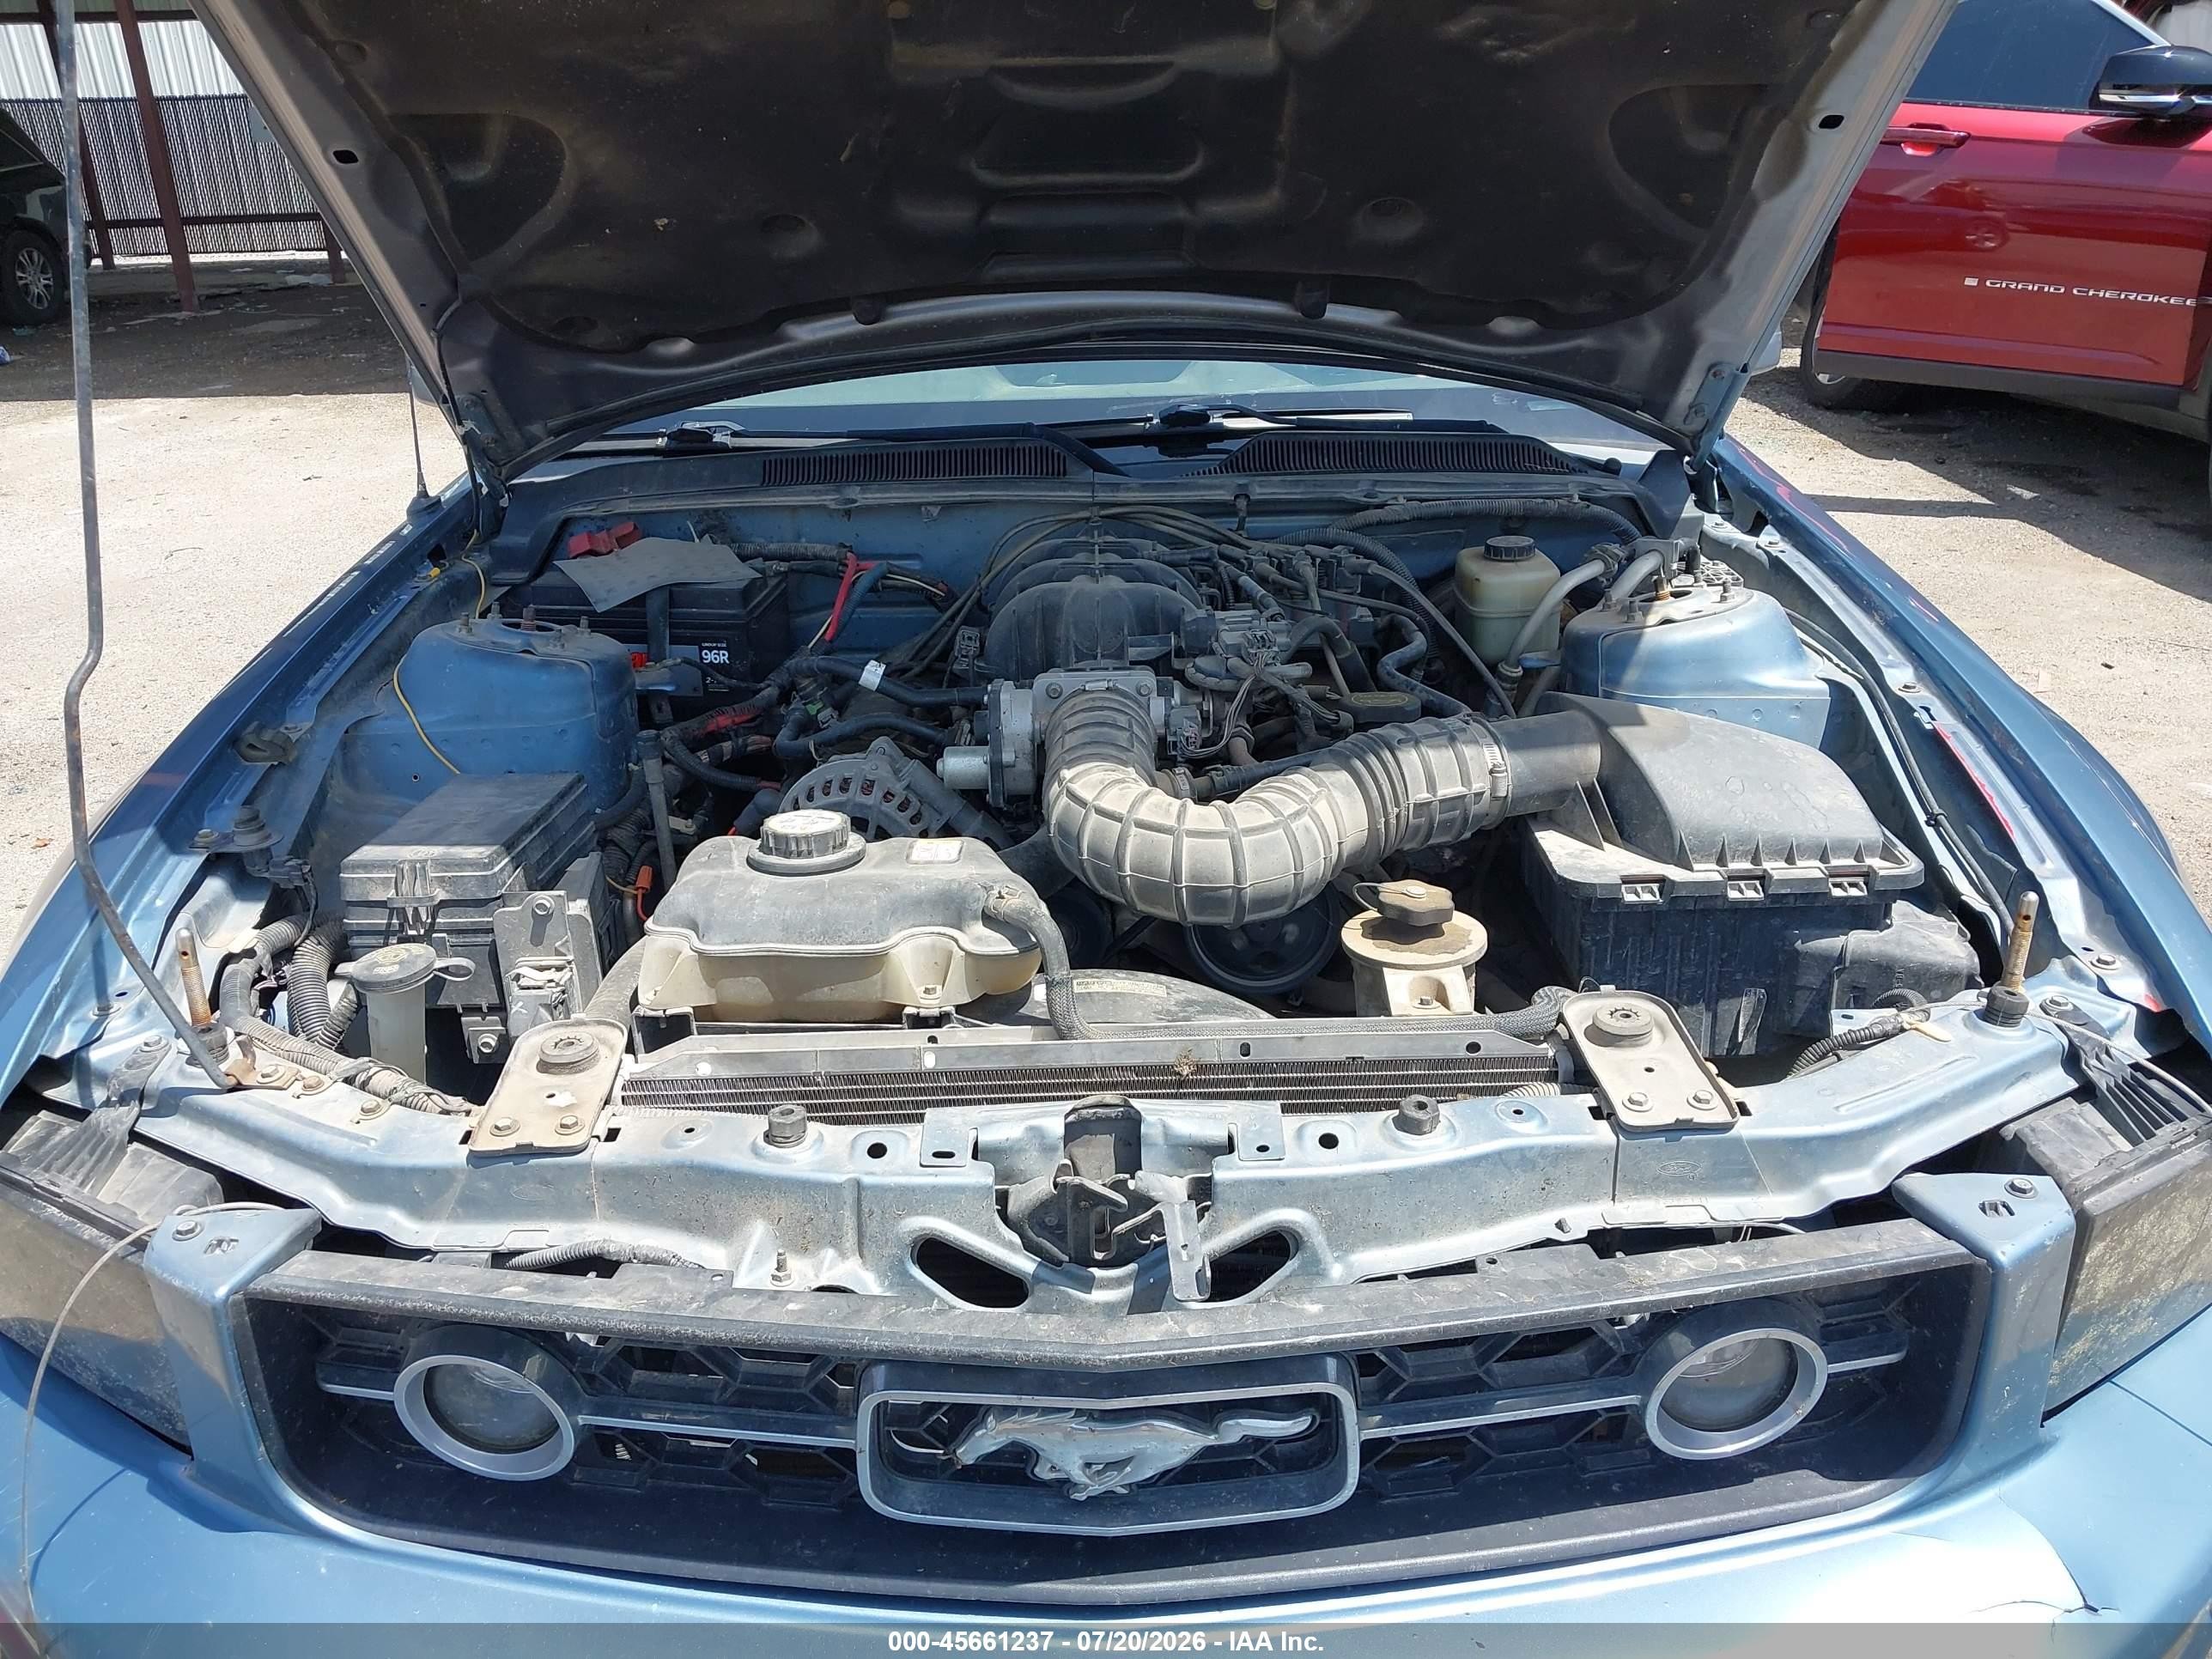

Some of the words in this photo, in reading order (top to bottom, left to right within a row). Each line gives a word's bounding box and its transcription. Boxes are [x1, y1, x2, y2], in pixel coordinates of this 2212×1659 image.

[1985, 279, 2065, 294] GRAND
[2072, 287, 2197, 307] CHEROKEE
[702, 649, 730, 664] 96R
